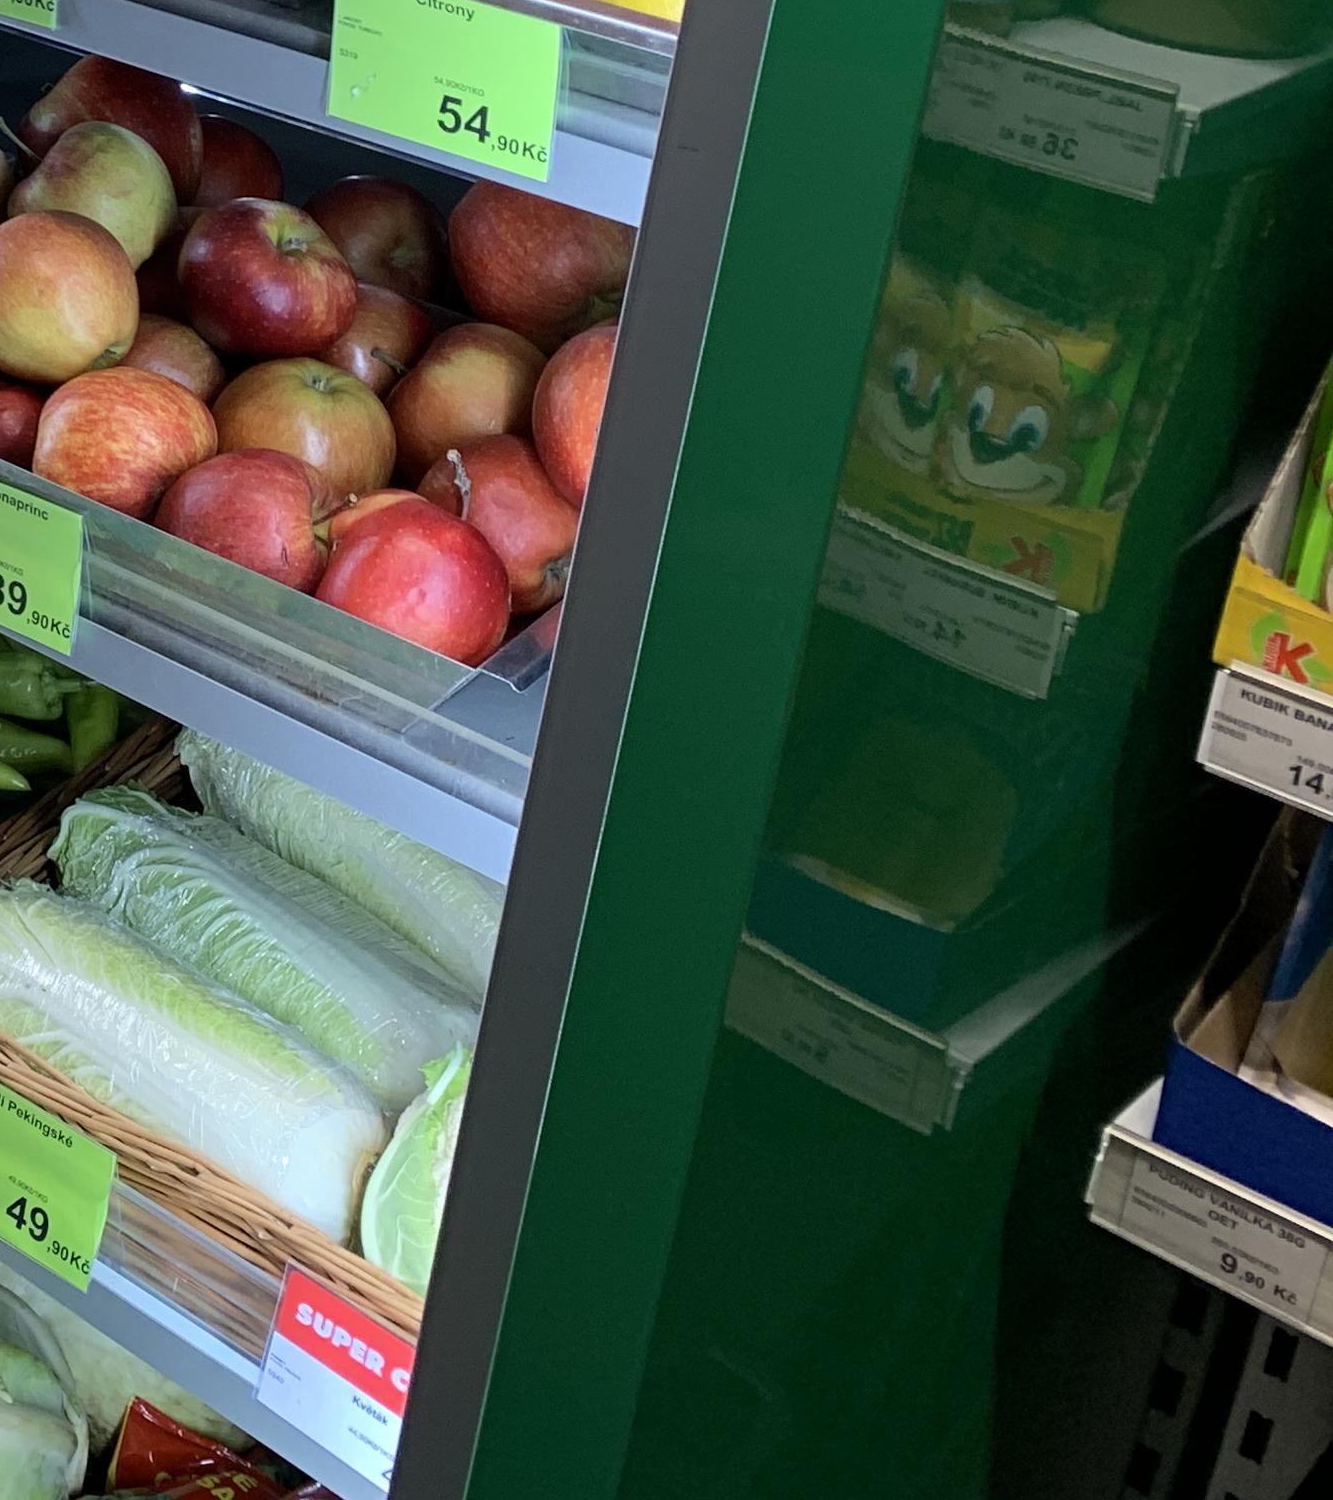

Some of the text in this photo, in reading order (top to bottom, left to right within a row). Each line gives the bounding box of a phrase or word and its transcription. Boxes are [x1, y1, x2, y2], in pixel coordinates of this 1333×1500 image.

[1240, 688, 1290, 717] KUBIK
[7, 1098, 74, 1148] Pekingské
[1208, 1210, 1240, 1231] OET
[1210, 1191, 1275, 1234] VANILKA
[294, 1301, 387, 1378] SUPER
[351, 1394, 389, 1428] Květák
